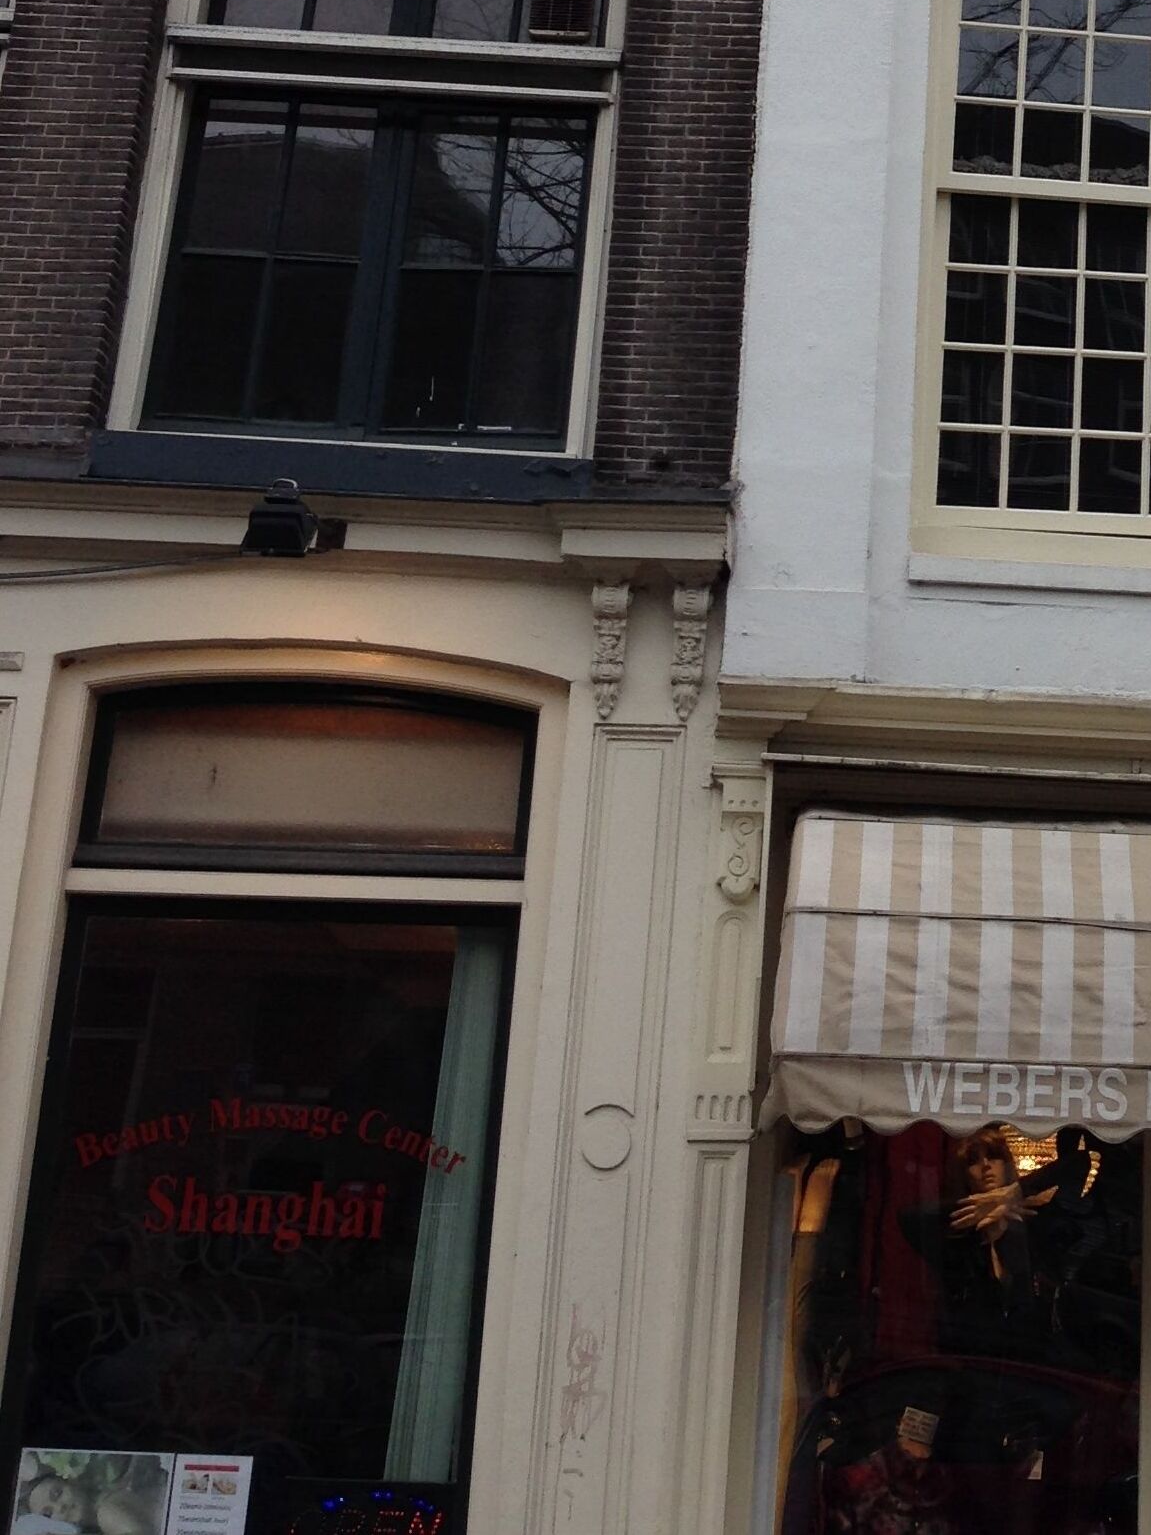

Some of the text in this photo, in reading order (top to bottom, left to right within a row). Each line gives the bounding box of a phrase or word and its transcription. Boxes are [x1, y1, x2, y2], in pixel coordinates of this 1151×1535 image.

[903, 1062, 1128, 1121] WEBERS
[73, 1097, 467, 1175] Beauty Massage Center
[143, 1174, 389, 1252] Shanghai
